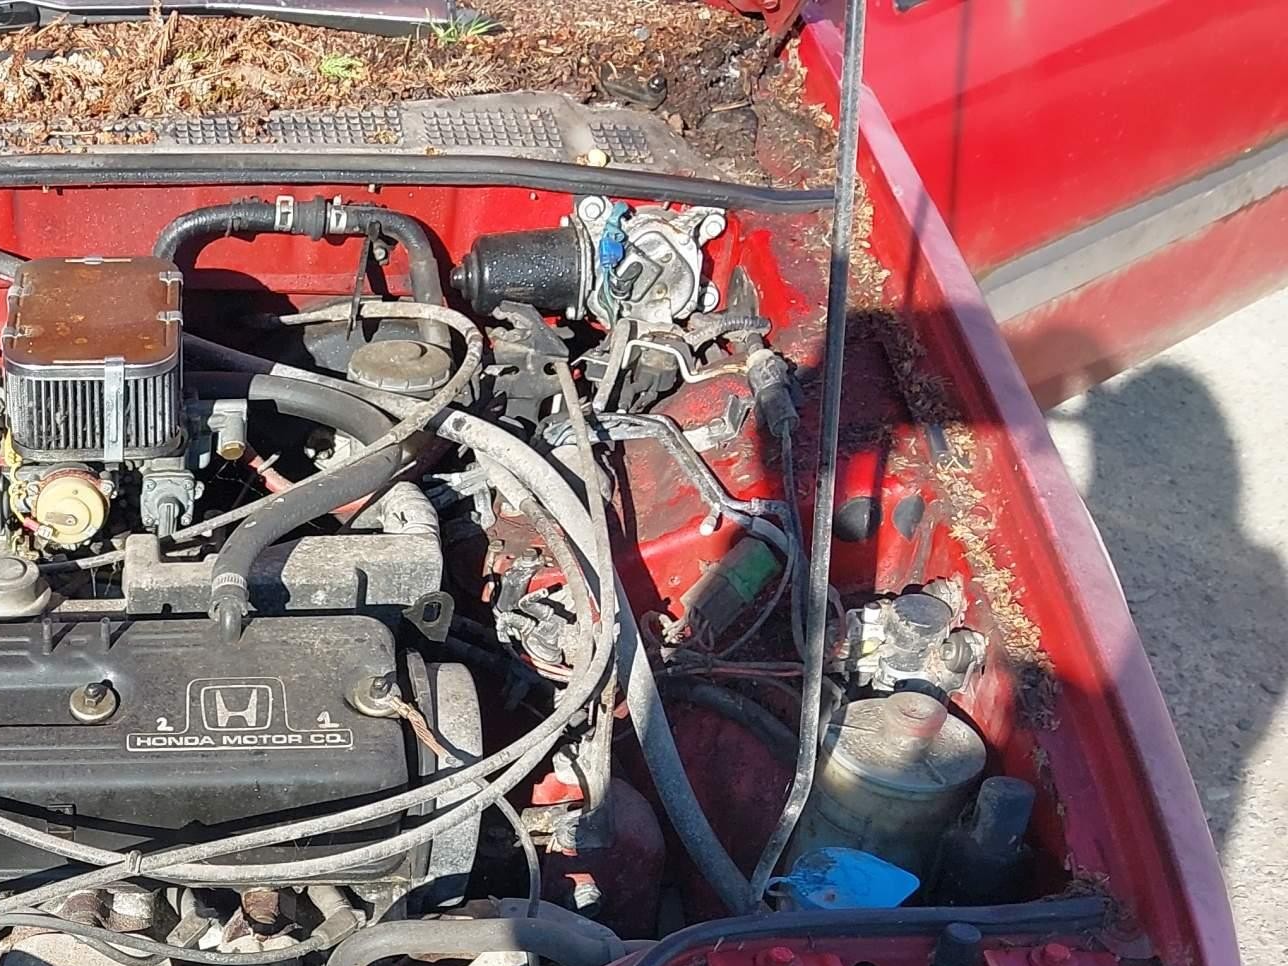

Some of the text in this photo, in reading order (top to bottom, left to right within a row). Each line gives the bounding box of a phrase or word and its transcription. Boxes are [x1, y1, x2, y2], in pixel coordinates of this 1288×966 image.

[156, 717, 174, 731] 2
[317, 711, 339, 728] 1
[136, 733, 346, 747] HONDA MOTOR CO.
